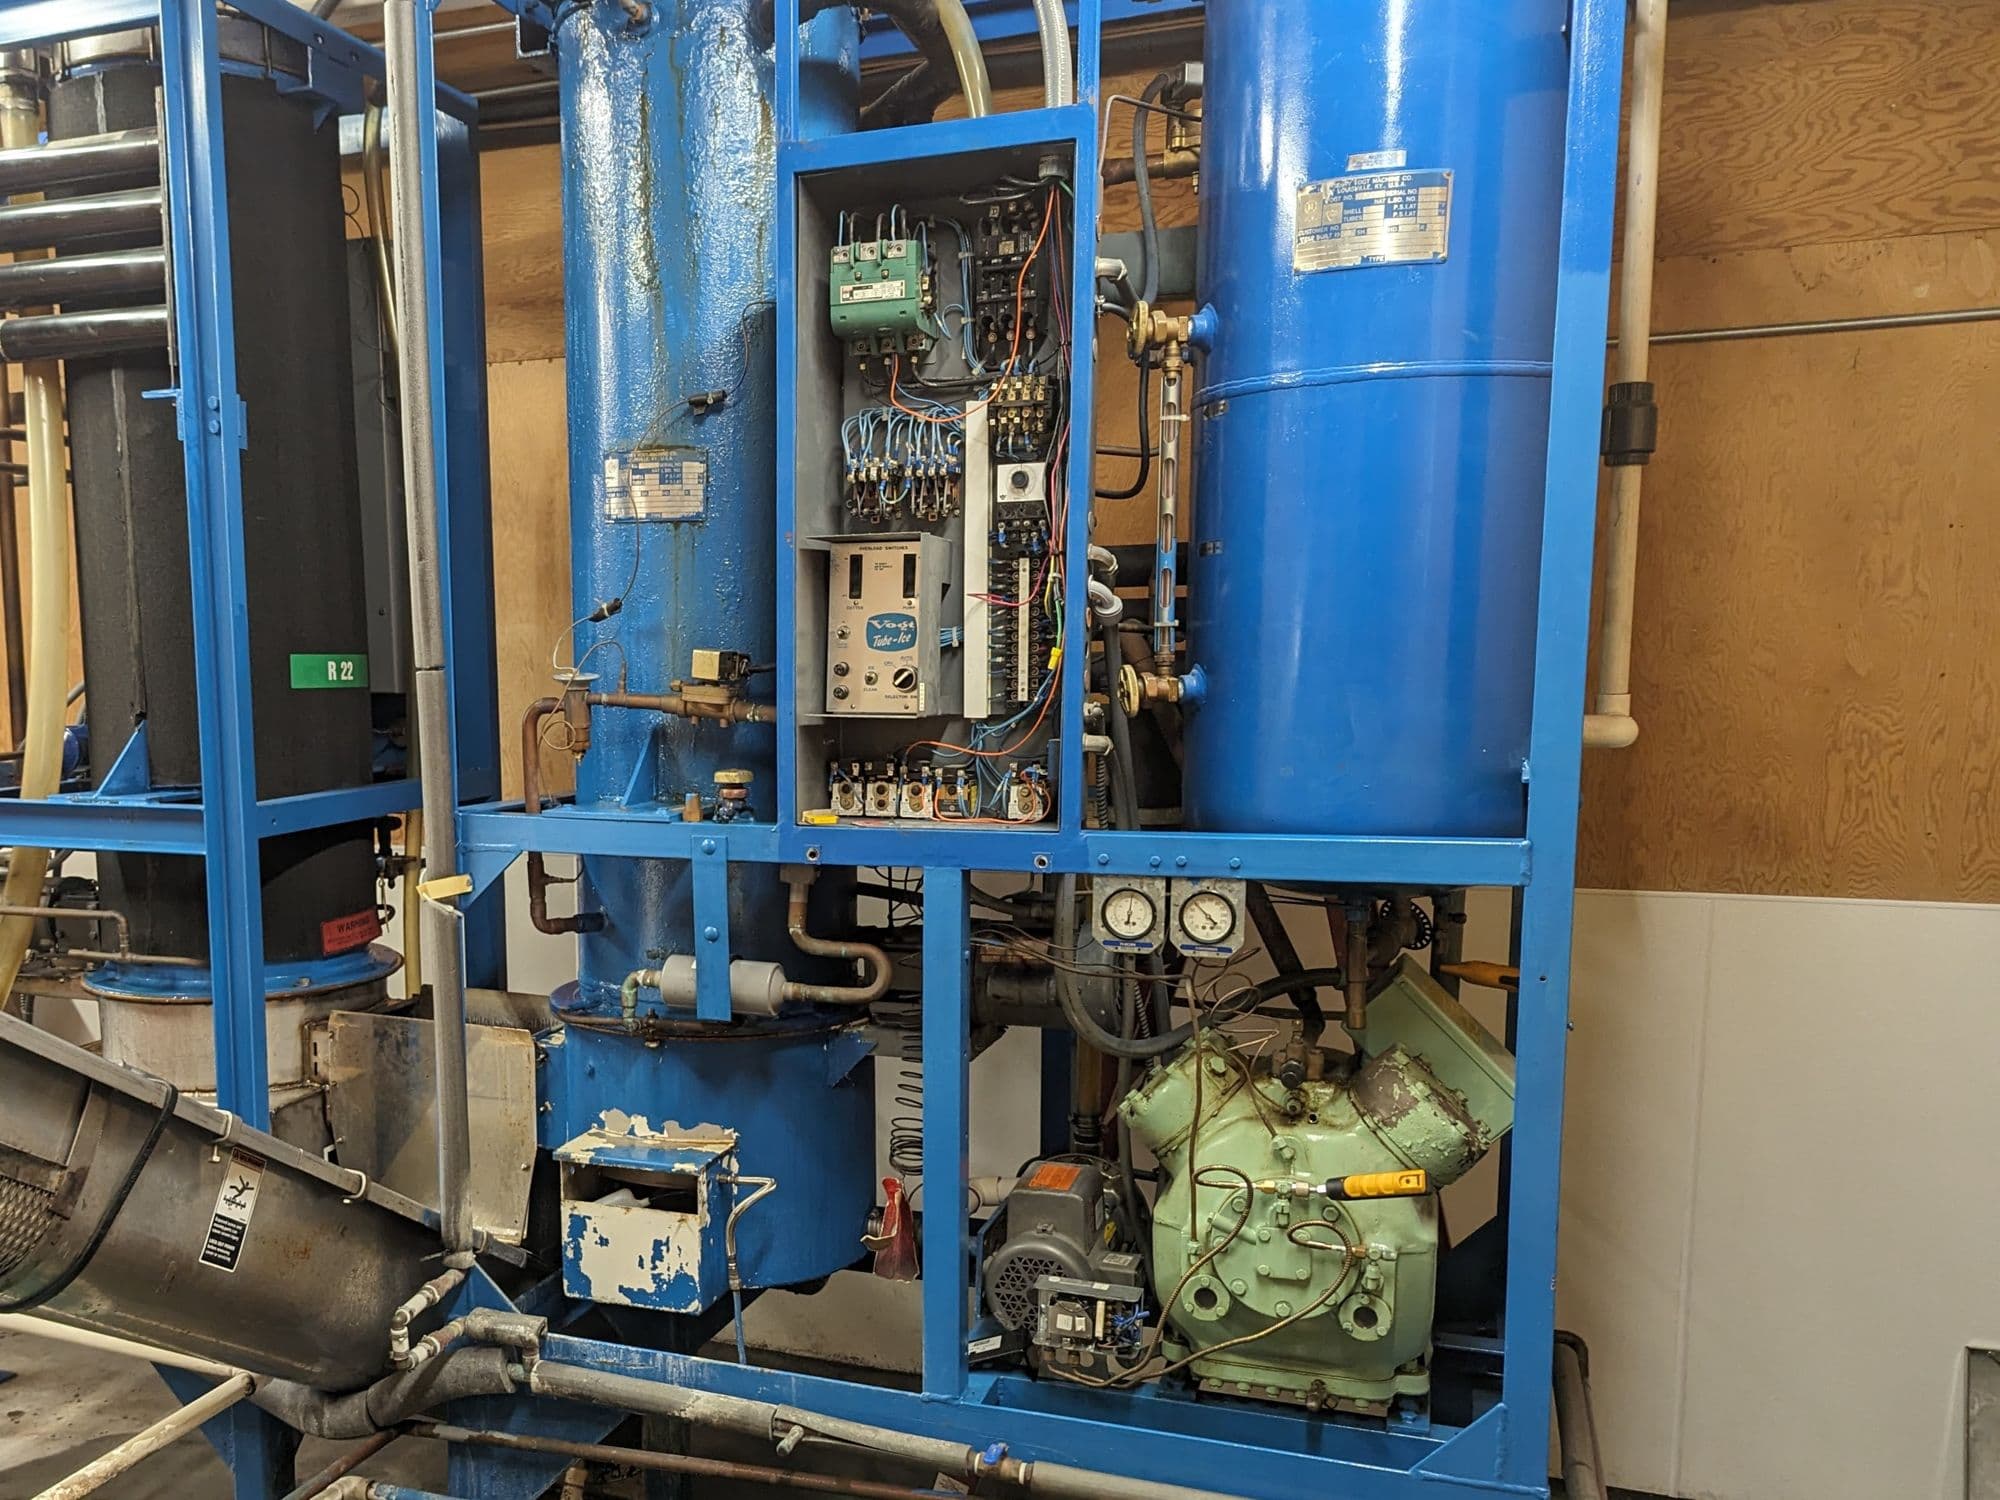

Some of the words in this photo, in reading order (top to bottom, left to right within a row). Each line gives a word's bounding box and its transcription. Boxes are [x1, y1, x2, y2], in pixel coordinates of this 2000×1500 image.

[868, 620, 915, 631] Vogt
[873, 632, 912, 648] Tube-Ice
[327, 660, 337, 681] R
[340, 660, 354, 681] 22
